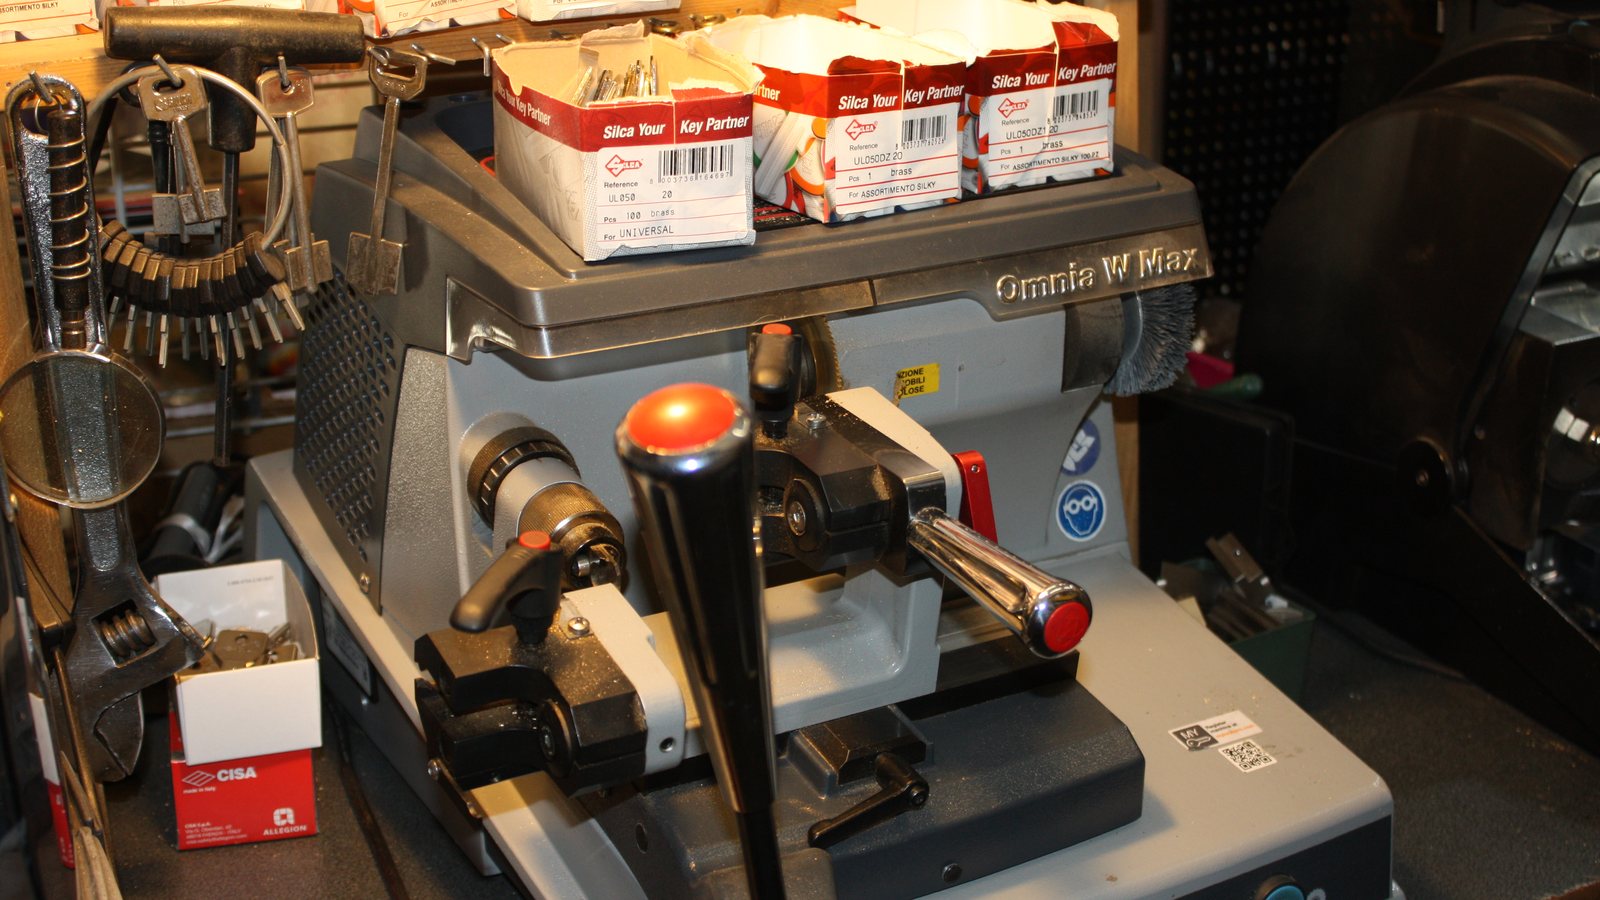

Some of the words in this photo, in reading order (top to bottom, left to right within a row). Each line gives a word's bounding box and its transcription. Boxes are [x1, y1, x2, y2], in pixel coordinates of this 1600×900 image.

[991, 75, 1020, 89] Silca
[1025, 72, 1050, 85] Your
[1058, 67, 1078, 82] Key
[1080, 62, 1116, 77] Partner
[838, 95, 868, 110] Silca
[872, 94, 898, 108] Your
[904, 89, 925, 104] Key
[927, 84, 965, 100] Partner
[516, 96, 527, 117] Key
[527, 102, 551, 126] Partner
[603, 125, 634, 139] Silca
[638, 122, 666, 136] Your
[680, 119, 704, 135] Key
[706, 115, 750, 131] Partner
[1001, 118, 1029, 126] Reference
[1005, 127, 1046, 140] UL050DZ1
[1049, 125, 1059, 133] 20
[849, 143, 878, 151] Reference
[1042, 140, 1063, 150] brass
[854, 152, 891, 166] UL050DZ
[892, 151, 903, 161] 20
[1012, 157, 1060, 171] ASSORTIMENTO
[1061, 154, 1079, 163] SILKY
[867, 172, 872, 180] 1
[890, 167, 913, 177] brass
[604, 181, 638, 189] Reference
[861, 184, 915, 199] ASSORTIMENTO
[916, 181, 936, 191] SILKY
[608, 193, 636, 202] UL050
[662, 191, 673, 199] 20
[626, 212, 641, 220] 100
[650, 209, 675, 218] brass
[619, 226, 674, 238] UNIVERSAL
[996, 262, 1096, 303] Omnia
[1102, 252, 1131, 284] W
[1138, 247, 1199, 279] Max
[902, 377, 925, 387] OBILI
[1180, 728, 1199, 740] MY
[216, 766, 257, 782] CISA
[263, 824, 307, 836] ALLEGION
